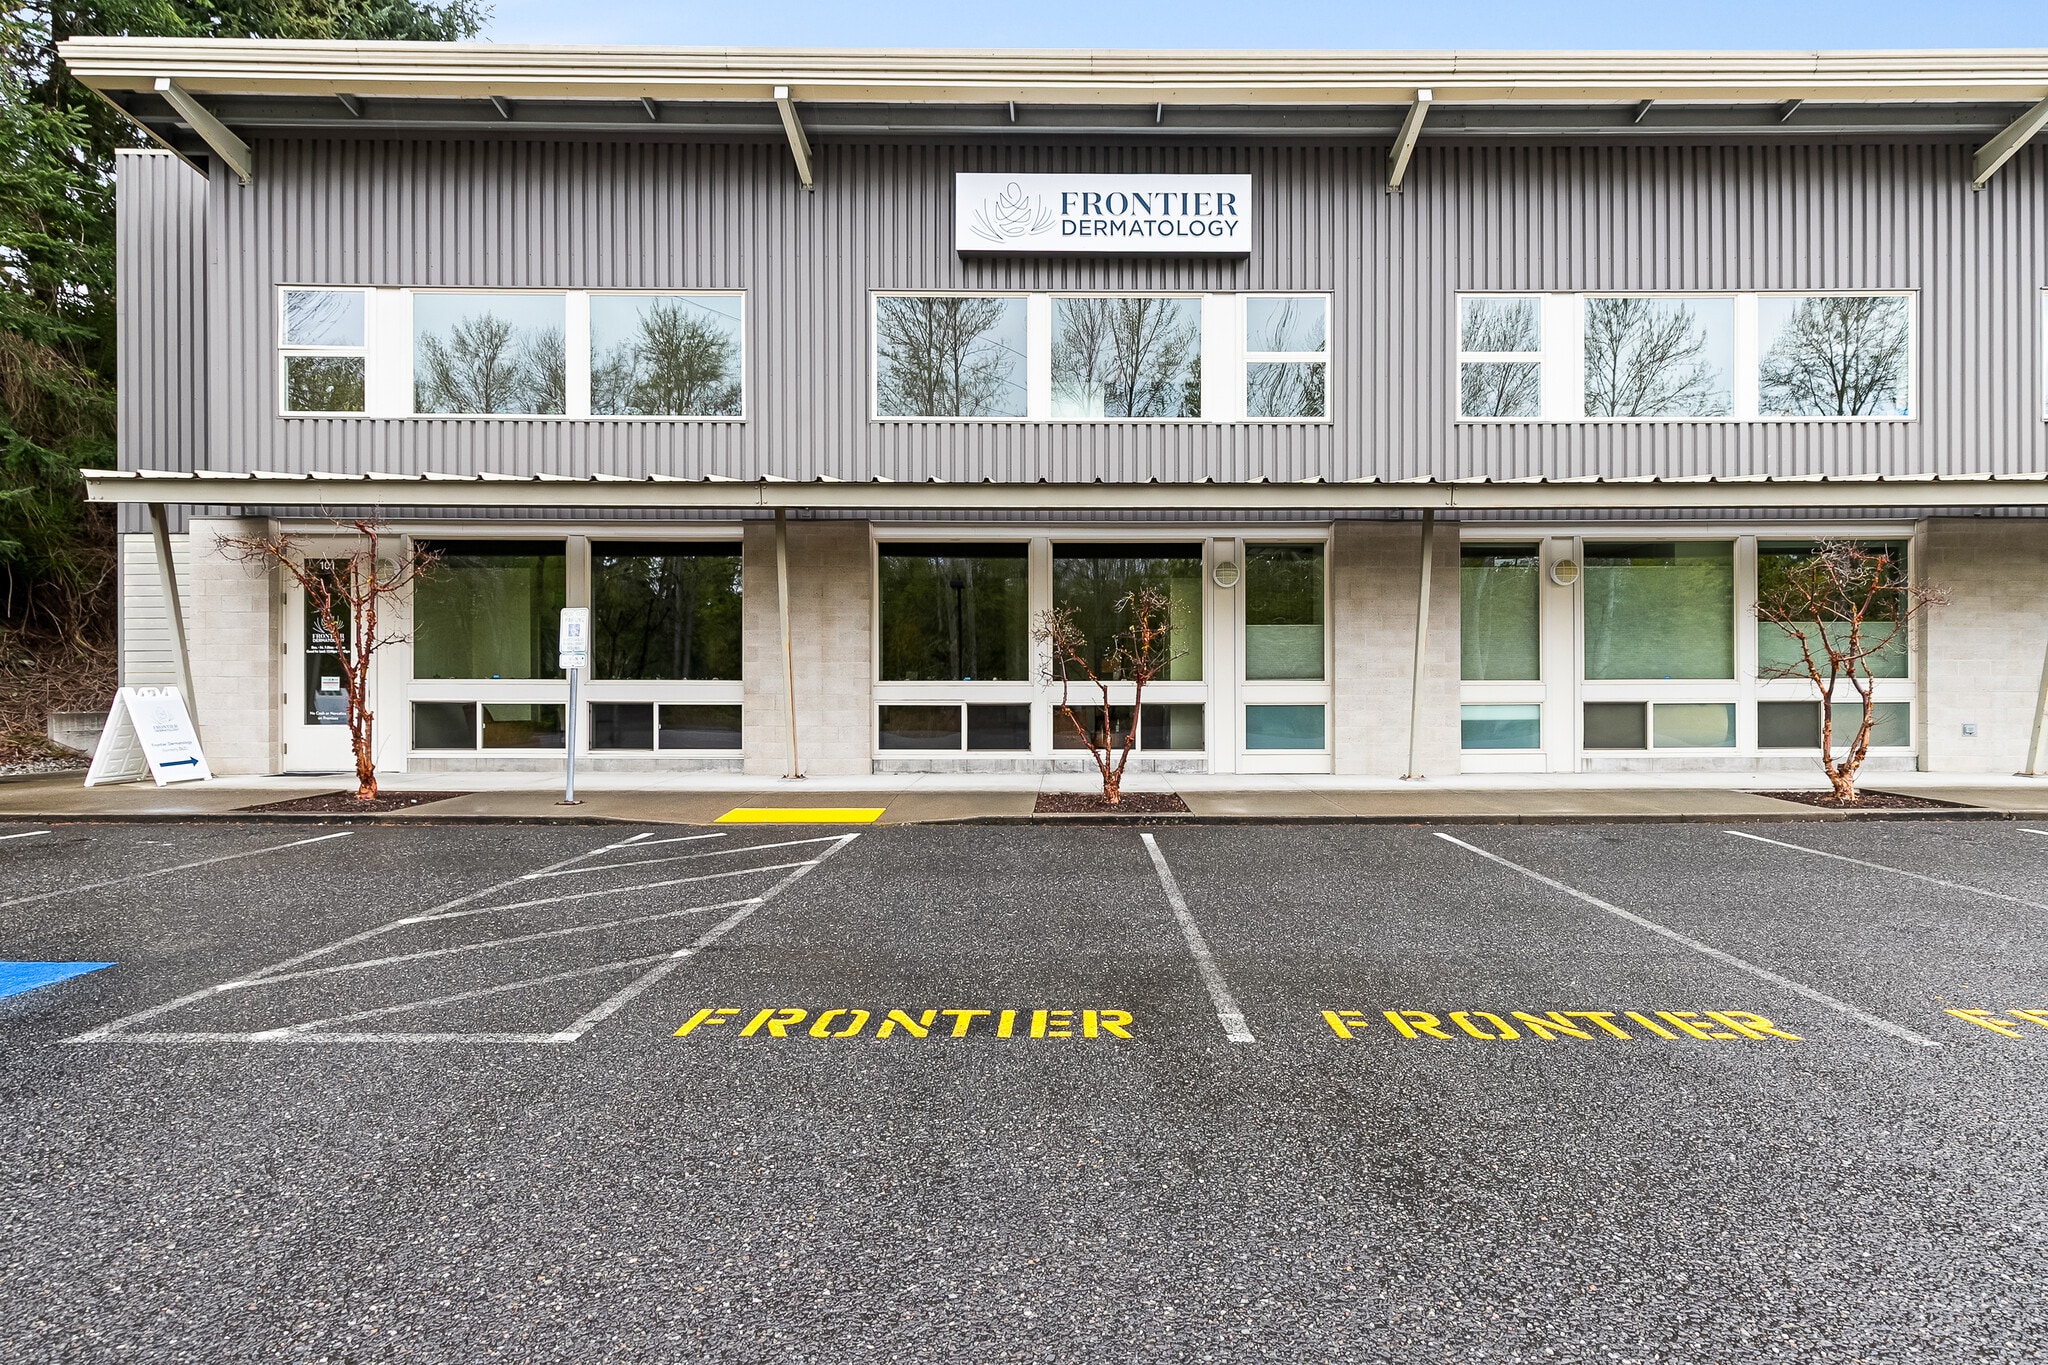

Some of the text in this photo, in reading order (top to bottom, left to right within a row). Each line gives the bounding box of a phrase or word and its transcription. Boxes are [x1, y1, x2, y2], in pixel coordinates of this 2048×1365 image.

[1060, 191, 1238, 216] FRONTIER
[1062, 219, 1239, 237] DERMATOLOGY
[320, 560, 335, 570] 101
[673, 1008, 1134, 1039] FRONTIER
[1321, 1010, 1802, 1041] FRONTIER
